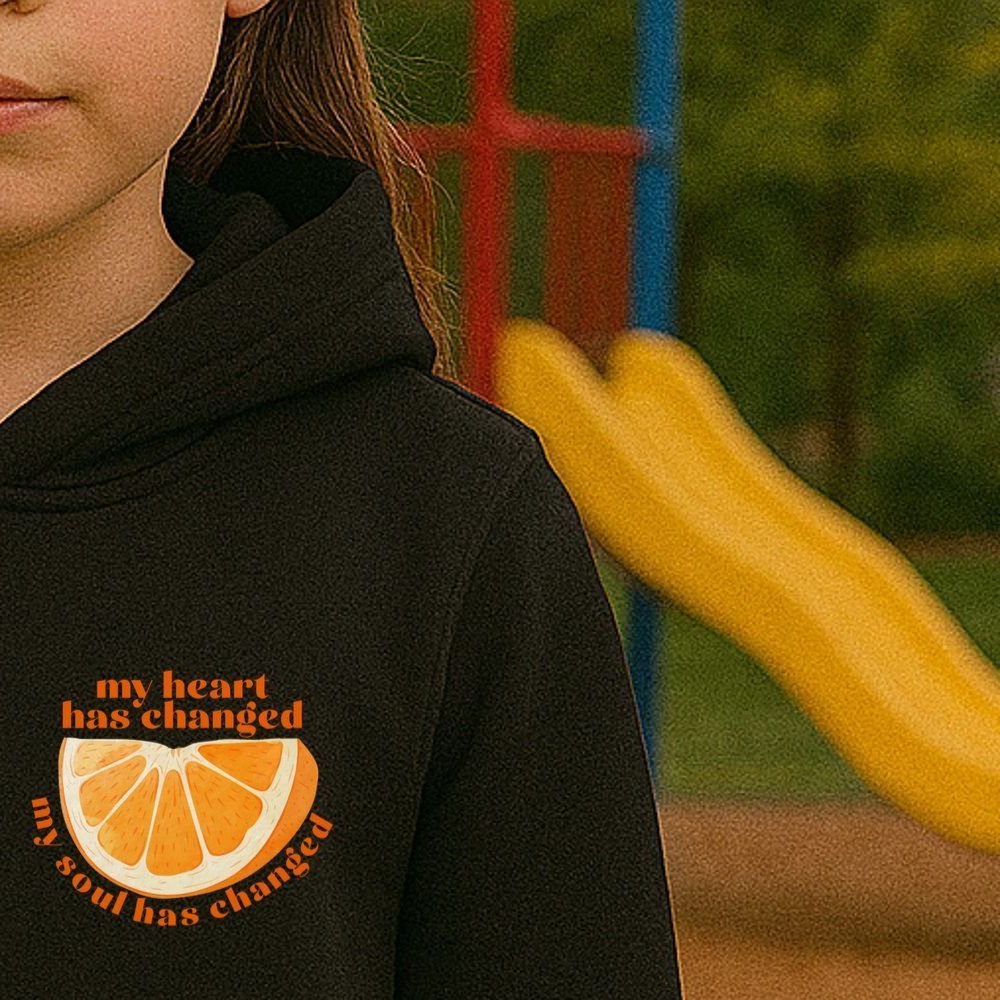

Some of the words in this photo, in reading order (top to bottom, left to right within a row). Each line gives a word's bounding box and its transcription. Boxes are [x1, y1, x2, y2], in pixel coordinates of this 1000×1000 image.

[96, 678, 152, 708] my
[162, 670, 270, 700] heart
[61, 700, 131, 730] has
[140, 699, 303, 738] changed
[31, 797, 61, 847] my
[55, 855, 128, 916] soul
[132, 897, 200, 927] has
[209, 812, 334, 919] changed
